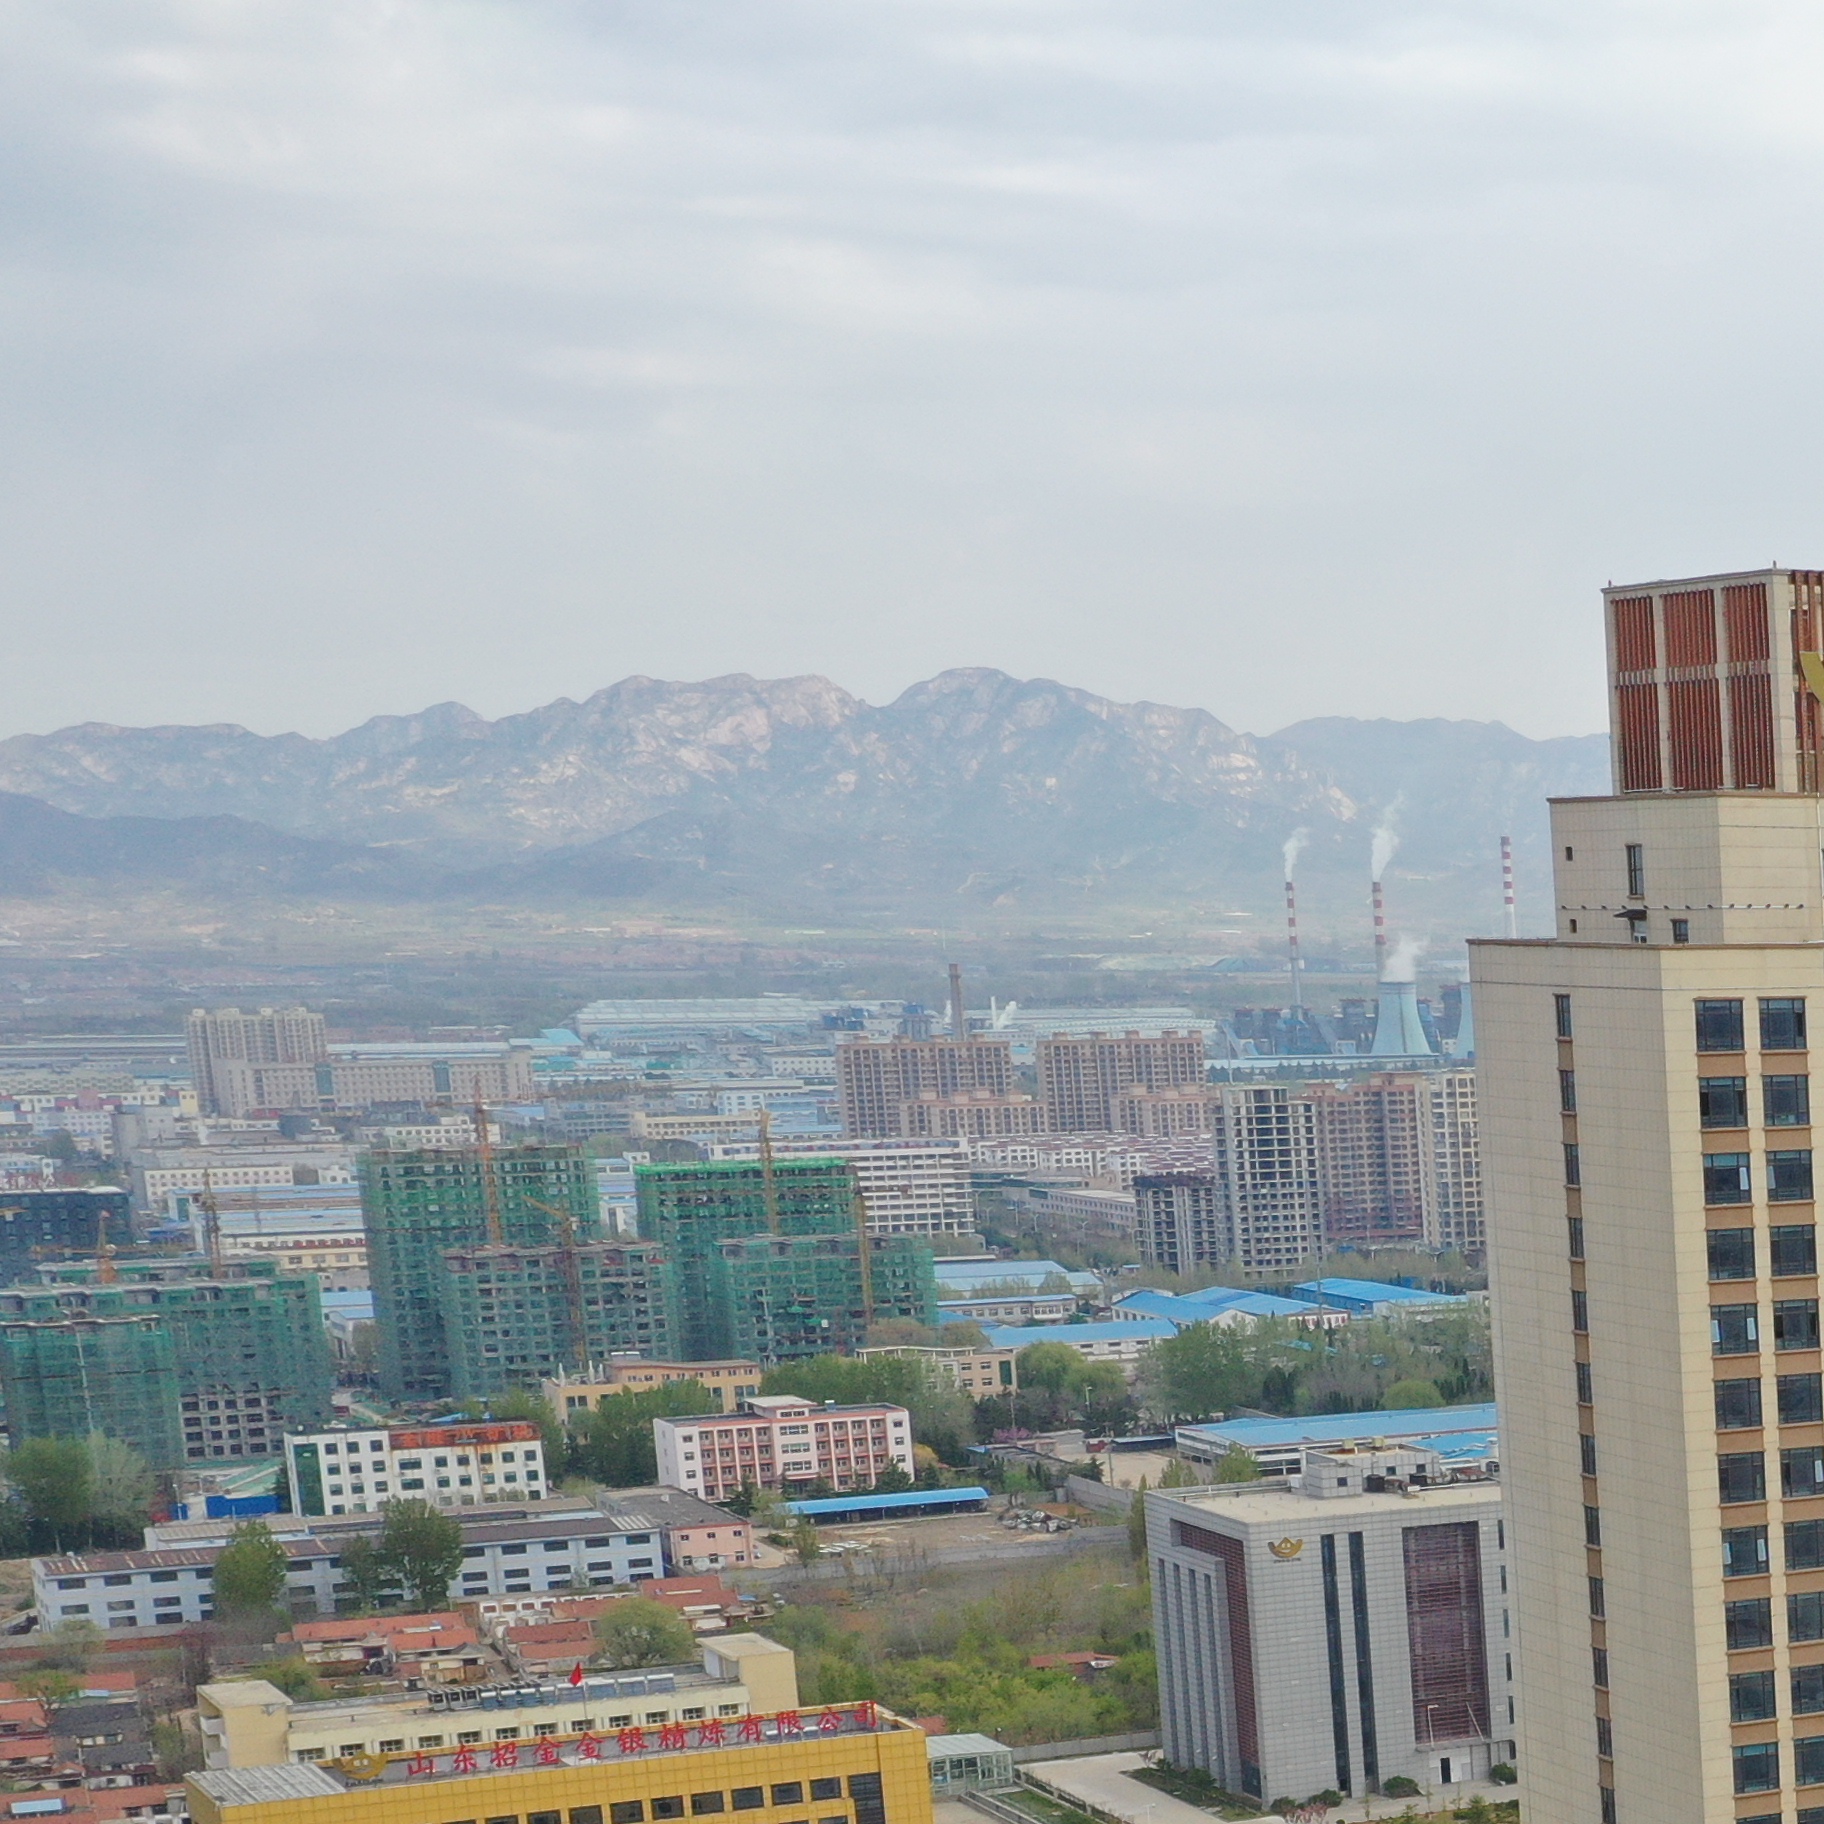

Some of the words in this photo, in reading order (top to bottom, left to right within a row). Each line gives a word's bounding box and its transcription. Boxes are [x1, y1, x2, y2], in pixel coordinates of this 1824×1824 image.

[406, 1699, 881, 1778] 山东招金金银精炼有限公司
